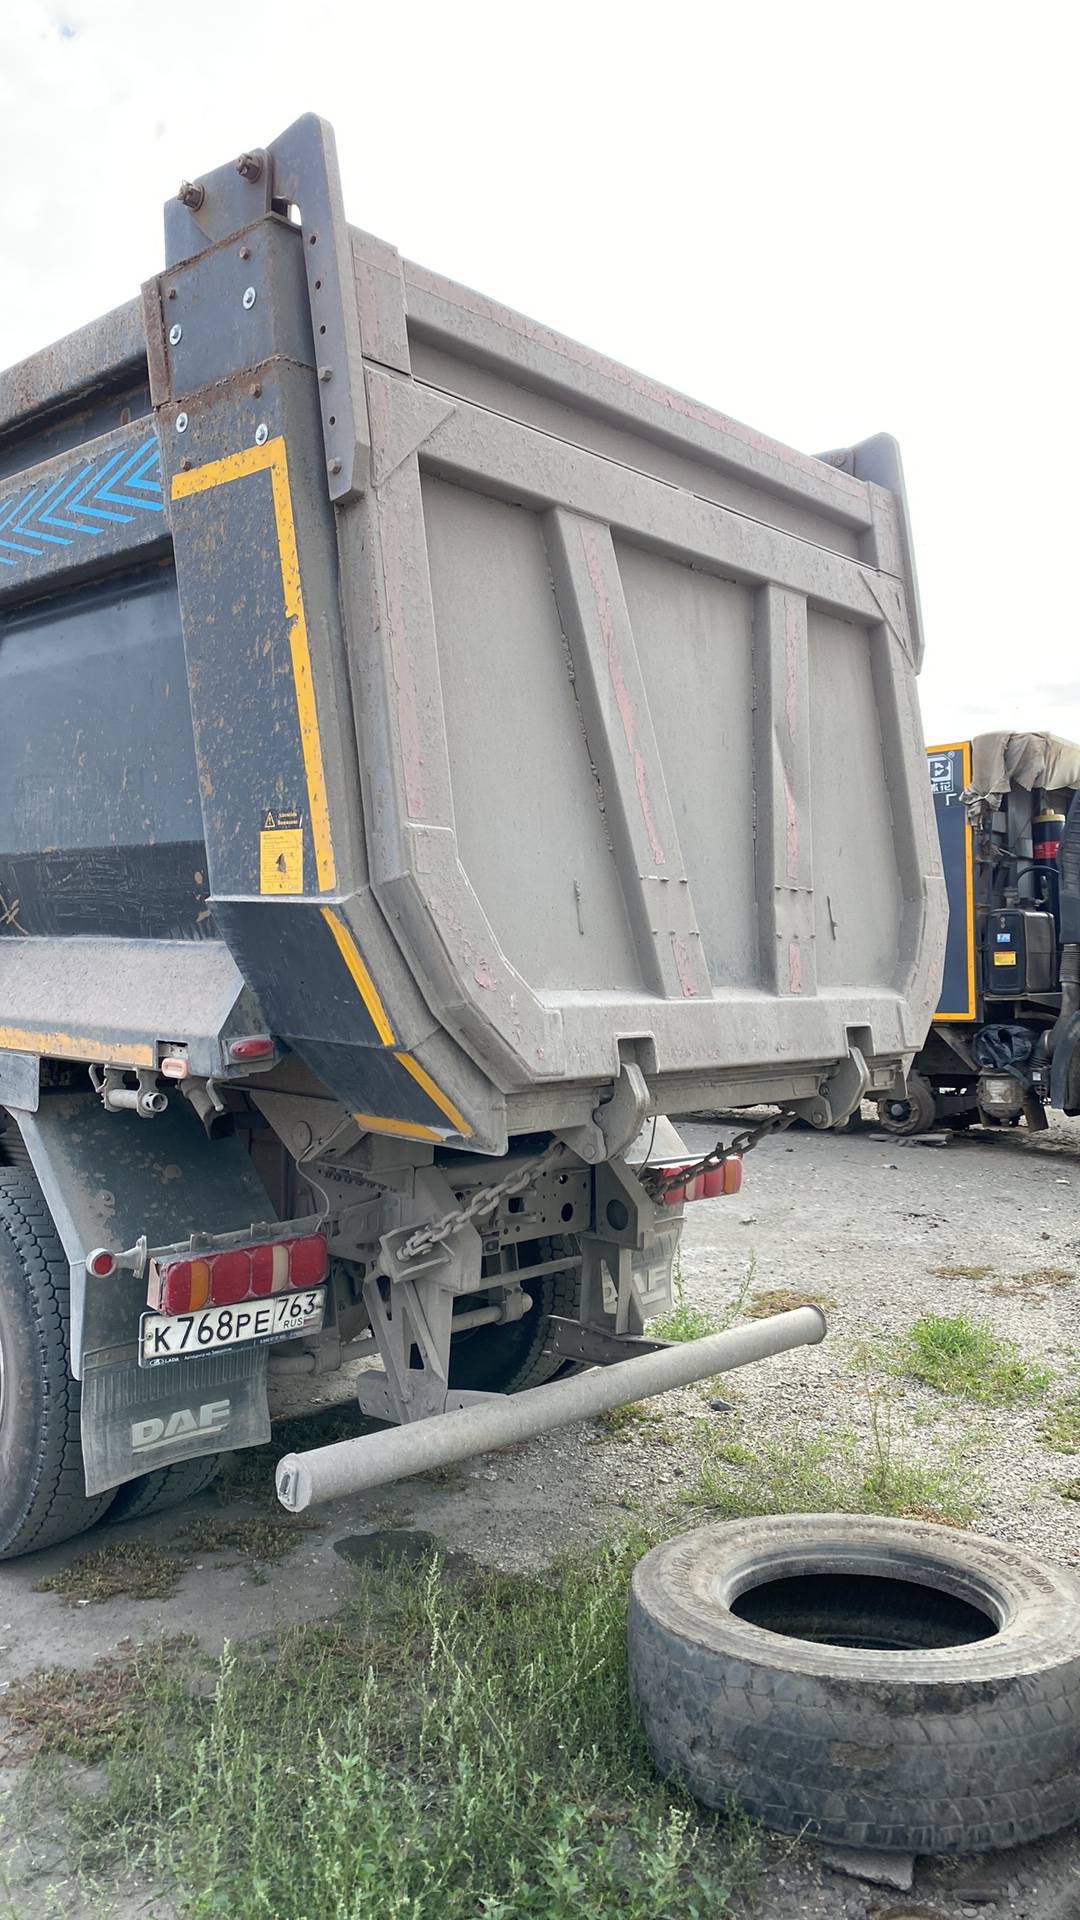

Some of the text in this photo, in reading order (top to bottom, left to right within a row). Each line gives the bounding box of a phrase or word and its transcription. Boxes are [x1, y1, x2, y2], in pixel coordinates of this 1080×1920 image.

[154, 1293, 317, 1352] К768РЕ 763
[283, 1317, 304, 1329] RUS
[131, 1399, 230, 1447] DAF
